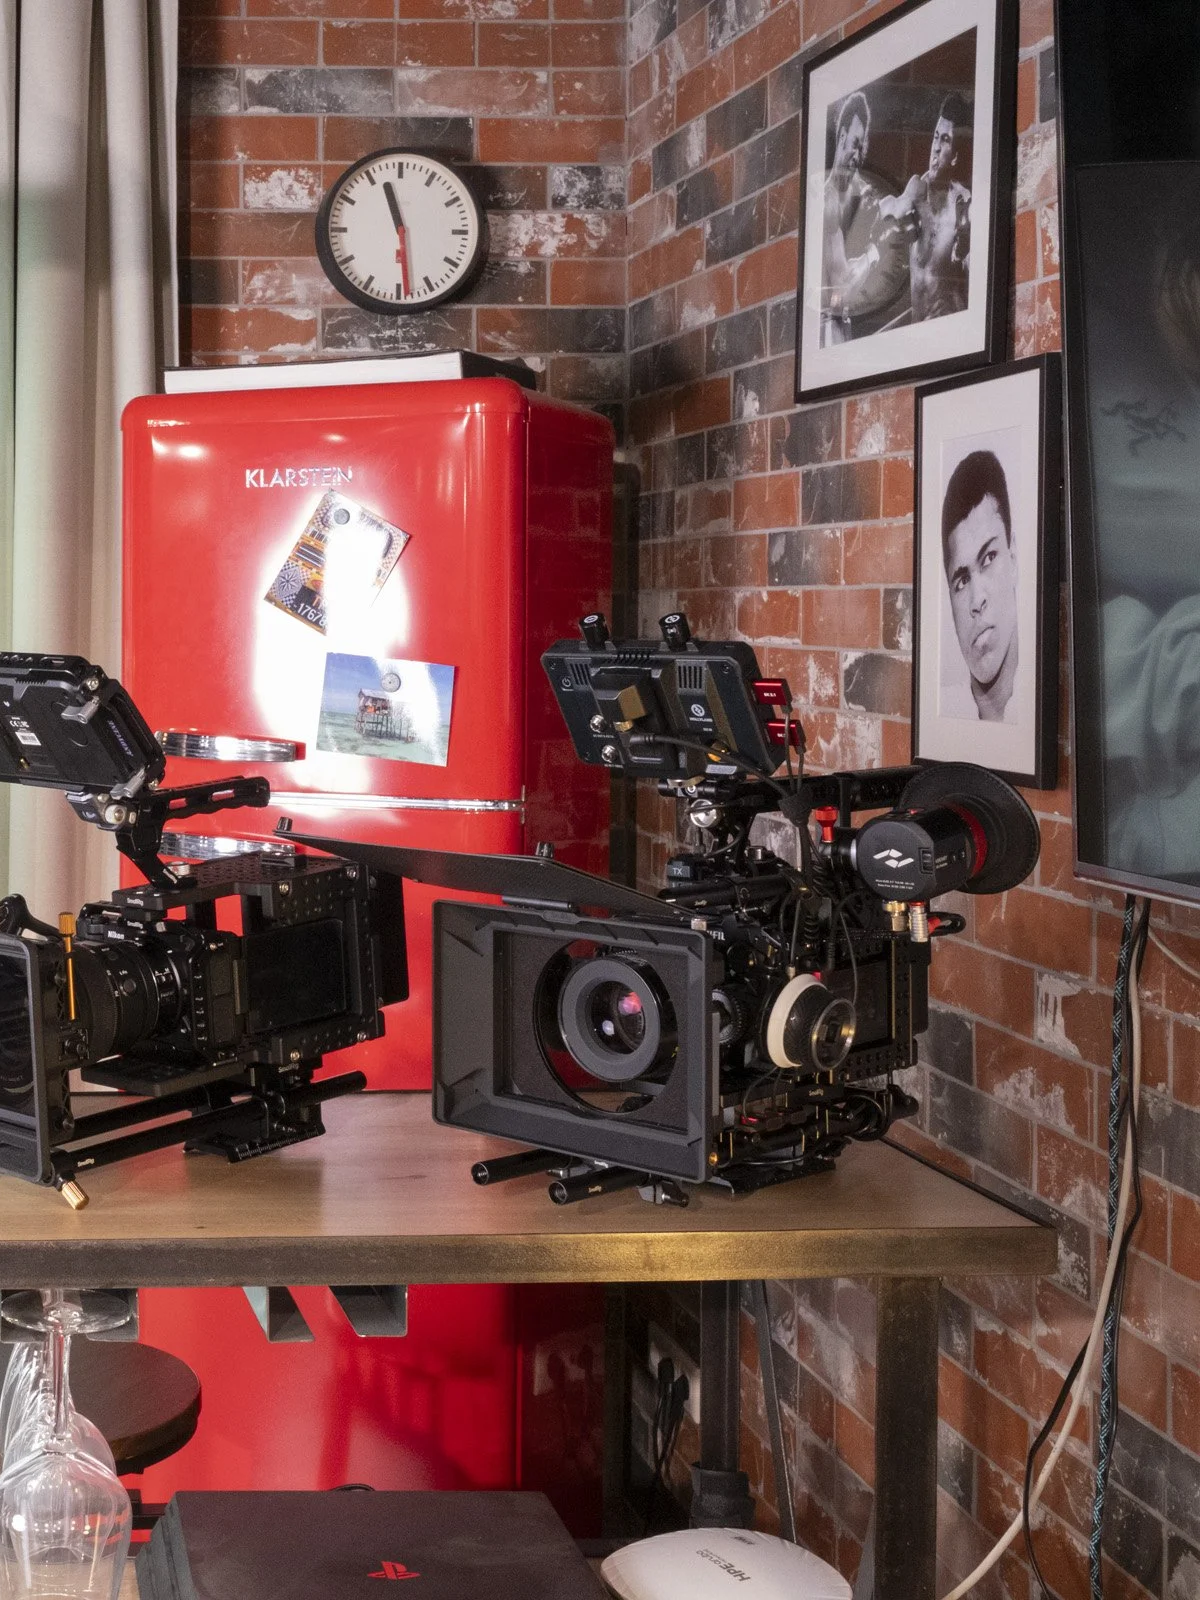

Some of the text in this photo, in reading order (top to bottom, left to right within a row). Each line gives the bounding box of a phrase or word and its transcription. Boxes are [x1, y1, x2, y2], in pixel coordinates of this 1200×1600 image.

[245, 467, 353, 488] KLARSTEIN
[672, 867, 683, 875] TX
[107, 930, 125, 939] Nikon
[720, 1562, 751, 1582] HPE
